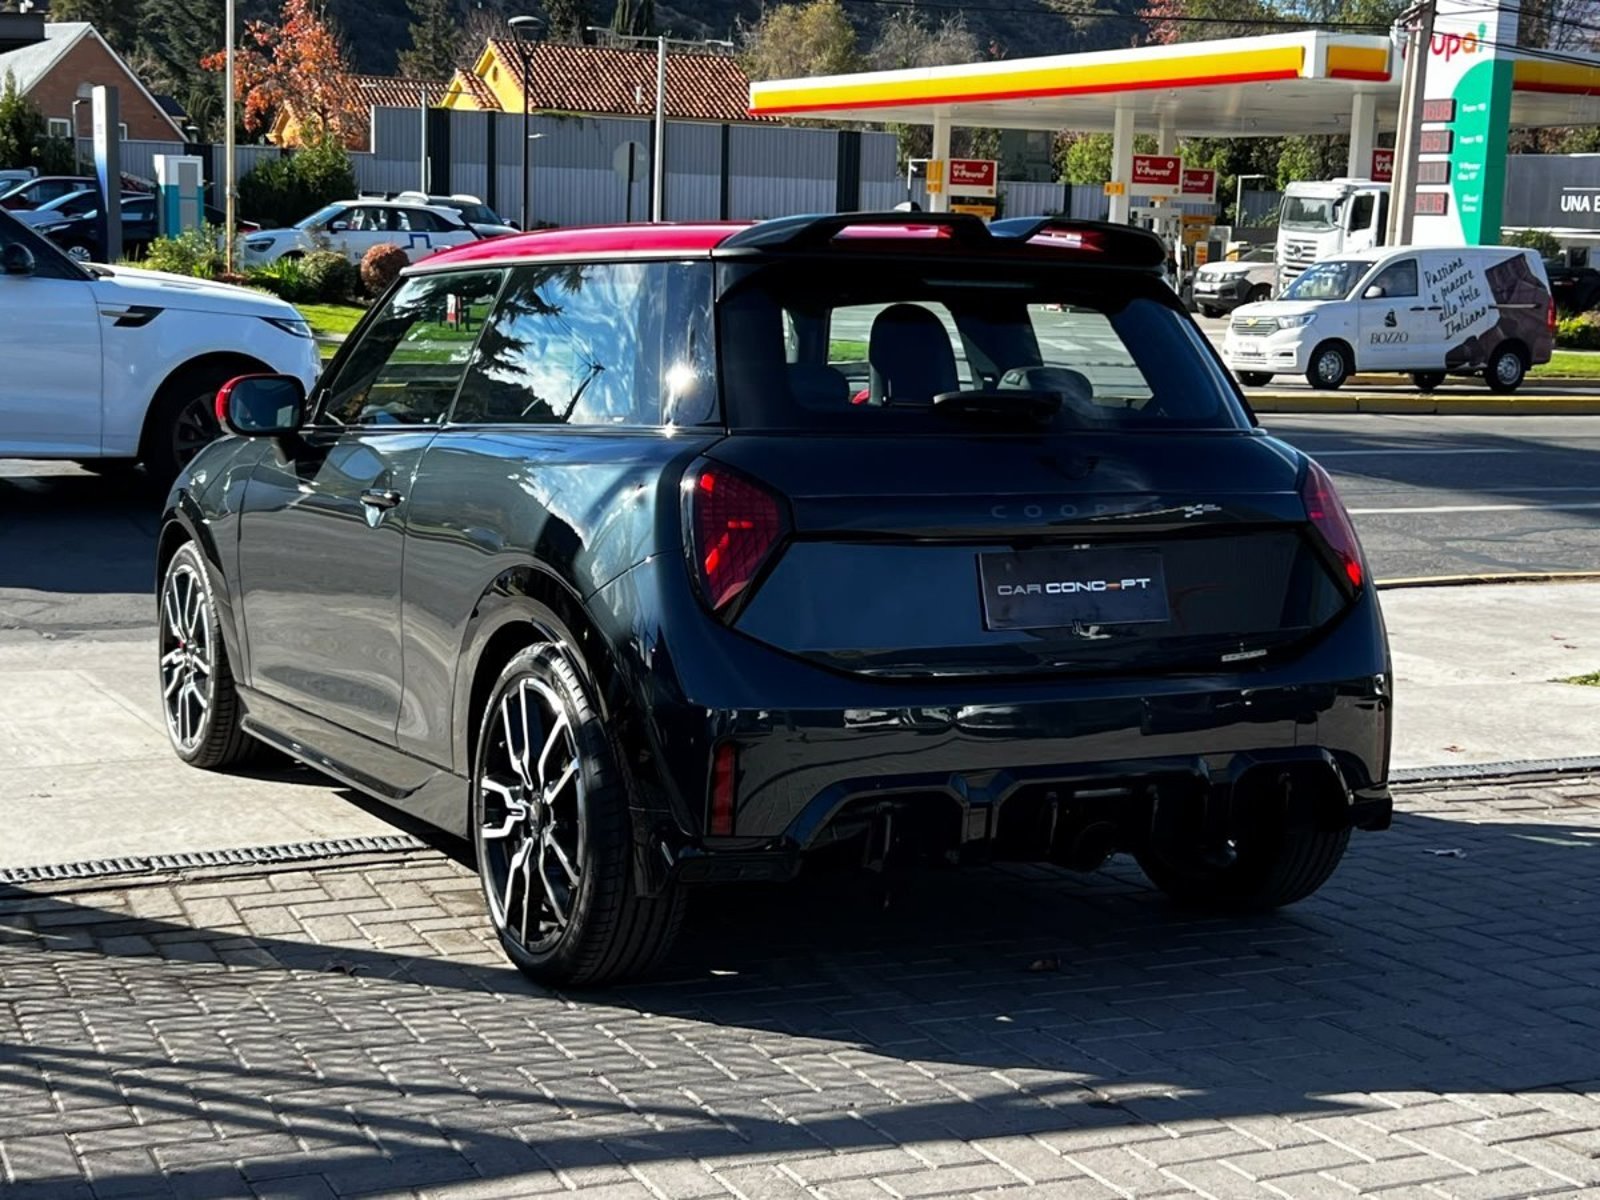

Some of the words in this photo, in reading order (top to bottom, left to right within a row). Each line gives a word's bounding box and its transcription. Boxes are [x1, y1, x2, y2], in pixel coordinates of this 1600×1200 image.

[1561, 195, 1590, 212] UNA
[1444, 306, 1486, 340] Italiano
[1370, 331, 1409, 345] BOZZO
[998, 583, 1042, 596] CAR
